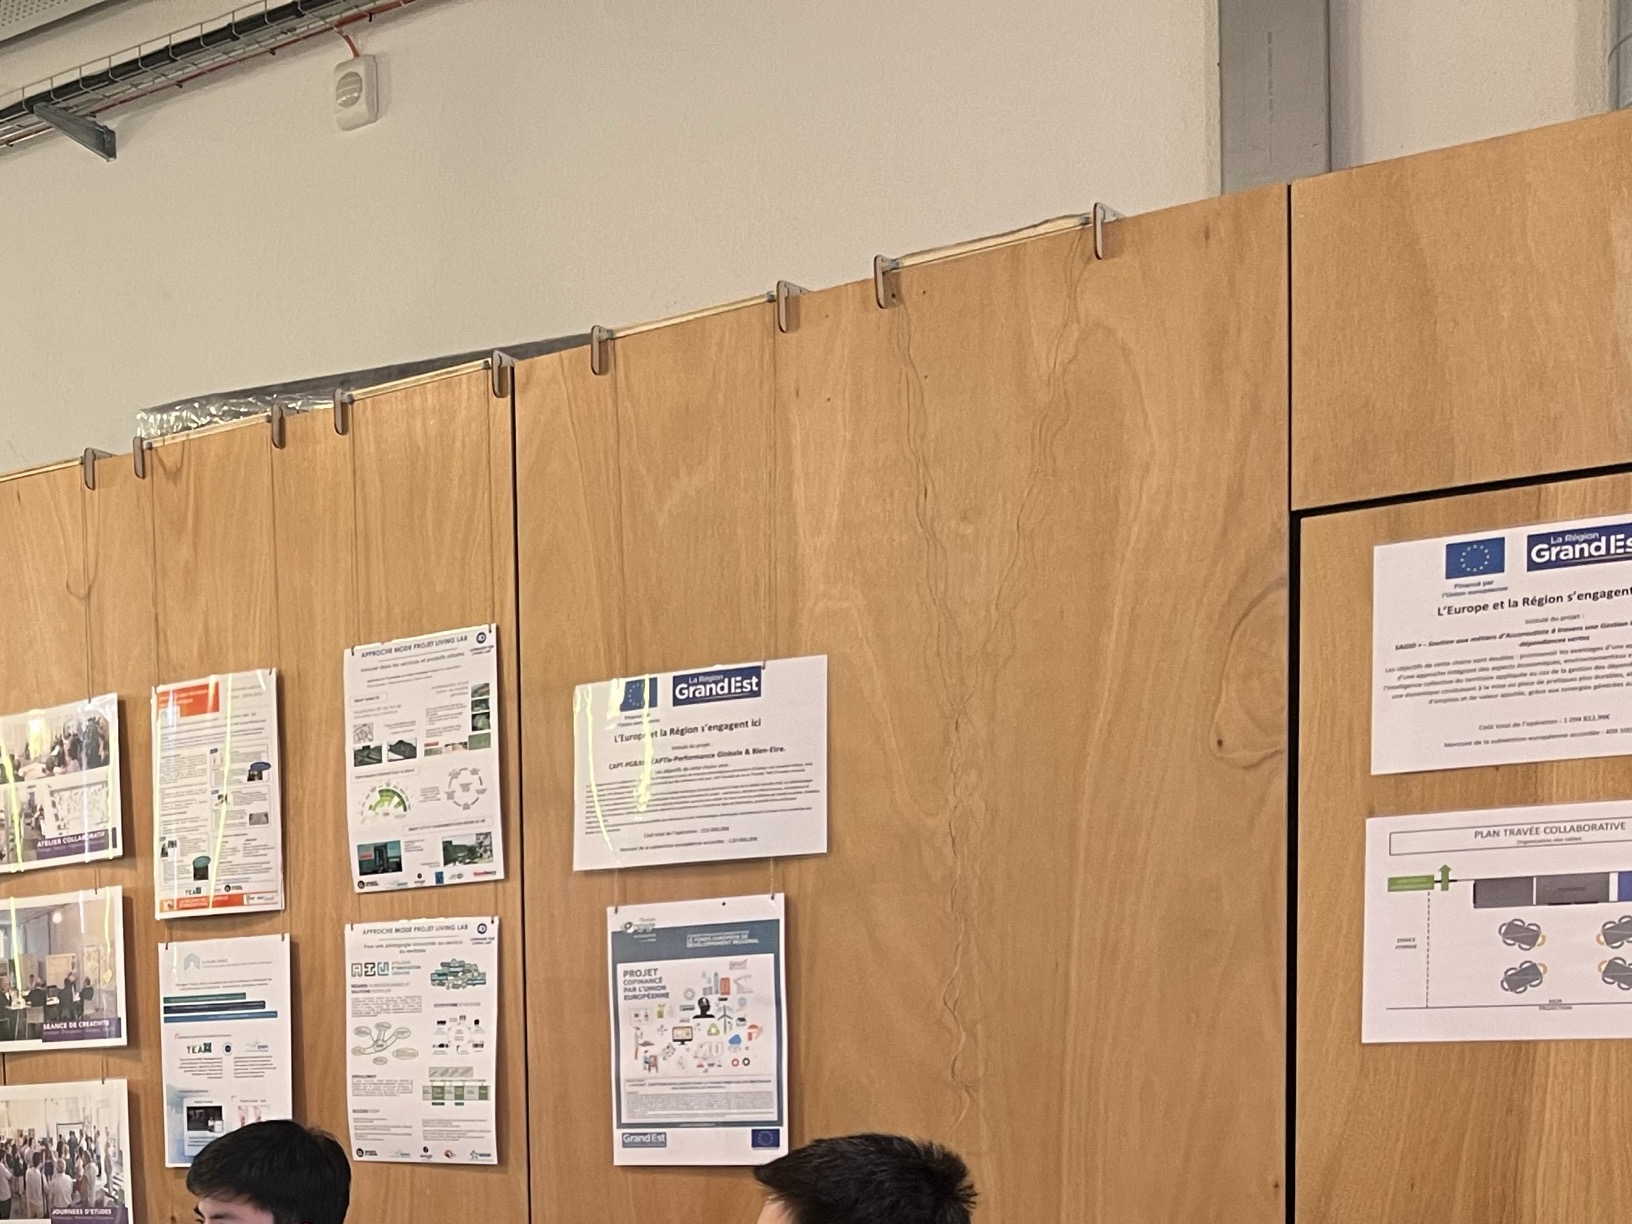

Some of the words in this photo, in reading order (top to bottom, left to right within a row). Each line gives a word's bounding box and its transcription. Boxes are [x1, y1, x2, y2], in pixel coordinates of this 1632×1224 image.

[1550, 536, 1564, 545] La
[1565, 532, 1599, 544] Région
[1531, 536, 1607, 563] Grand
[1610, 533, 1632, 555] Es
[1438, 604, 1489, 617] L'Europe
[1492, 601, 1505, 611] et
[1508, 598, 1518, 608] la
[1522, 593, 1564, 608] Région
[436, 638, 456, 646] LIVING
[675, 678, 728, 700] Grand
[730, 675, 759, 694] Est
[614, 732, 646, 744] L'Europ
[670, 726, 699, 738] Région
[701, 720, 749, 733] s'engagent
[751, 718, 762, 727] ici
[1474, 829, 1500, 840] PLAN
[1504, 825, 1540, 838] TRAVÉE
[1544, 821, 1626, 835] COLLABORATIVE
[37, 838, 62, 848] ATELIER
[623, 968, 658, 978] PROJET
[623, 976, 663, 986] COFINANCÉ
[623, 1134, 650, 1143] Grand
[652, 1134, 666, 1142] Est
